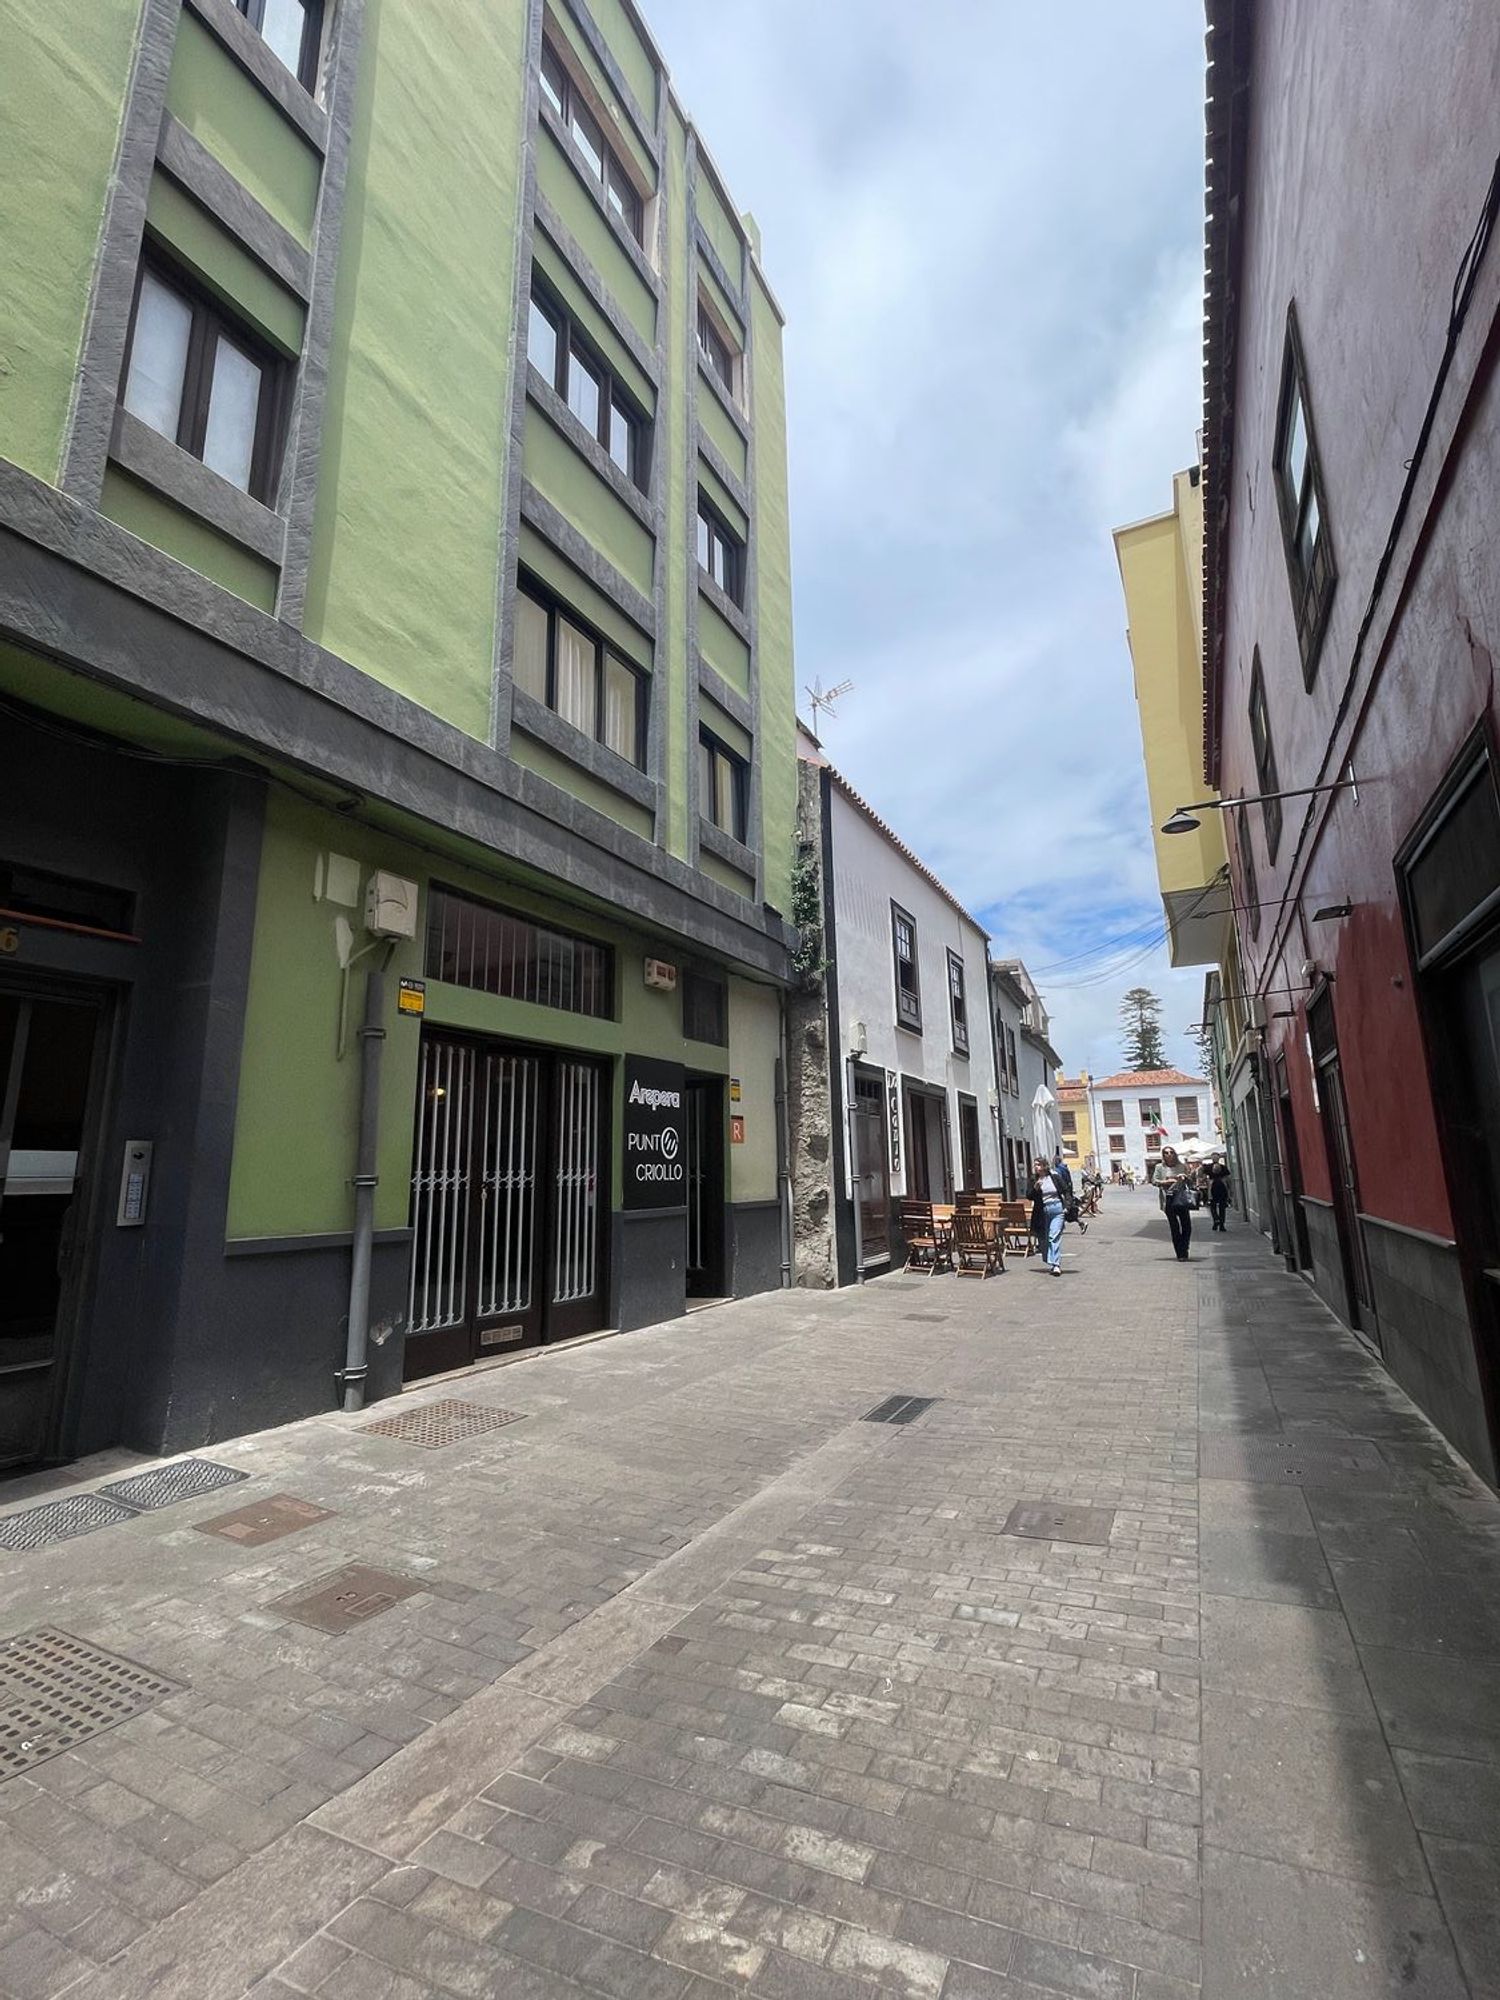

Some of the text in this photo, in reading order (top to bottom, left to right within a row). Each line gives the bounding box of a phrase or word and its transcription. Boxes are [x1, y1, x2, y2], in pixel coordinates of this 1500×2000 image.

[629, 1079, 680, 1111] Arepera
[733, 1122, 741, 1140] R
[635, 1163, 683, 1182] CRIOLLO
